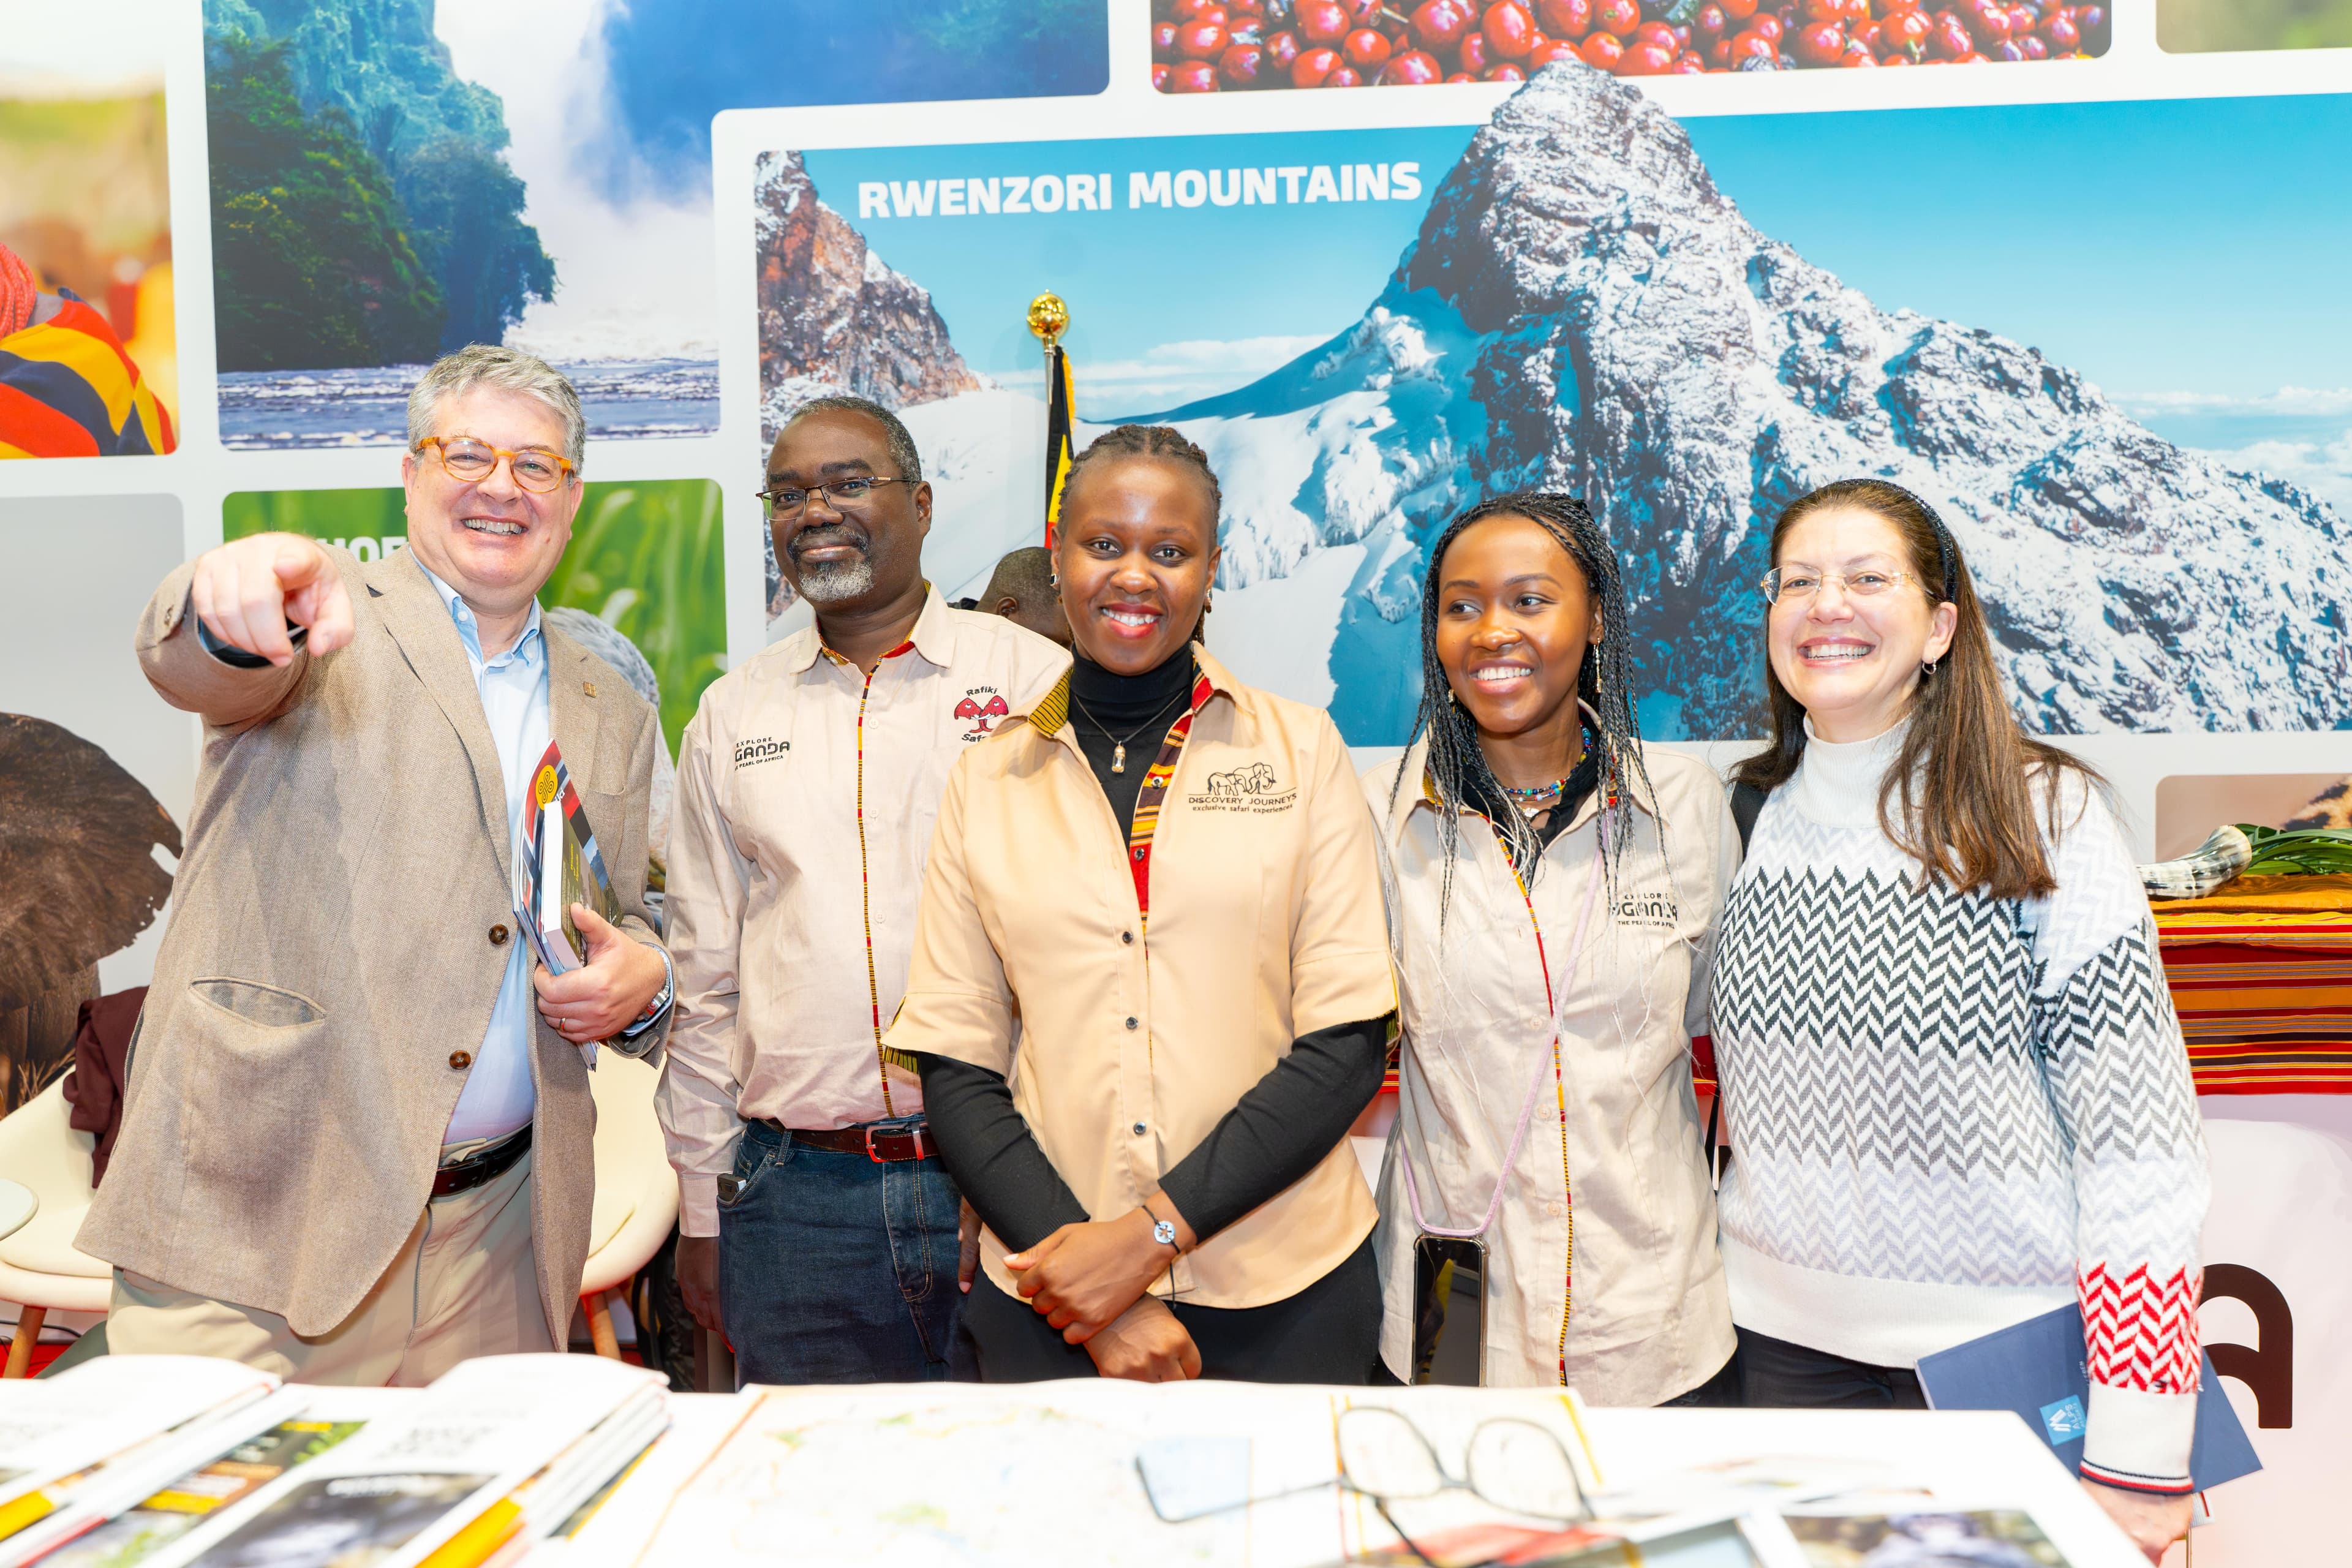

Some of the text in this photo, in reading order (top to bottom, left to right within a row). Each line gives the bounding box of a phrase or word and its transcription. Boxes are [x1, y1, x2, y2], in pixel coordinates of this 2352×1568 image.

[858, 161, 1422, 219] RWENZORI MOUNTAINS
[966, 686, 998, 696] Rafiki
[736, 736, 772, 748] EXPLORE
[735, 741, 790, 763] GANDA
[739, 760, 755, 769] PEARL
[764, 755, 784, 763] AFRICA
[1248, 793, 1297, 805] JOURNEYS
[1253, 804, 1293, 815] experiences
[2065, 1404, 2081, 1430] ALPS
